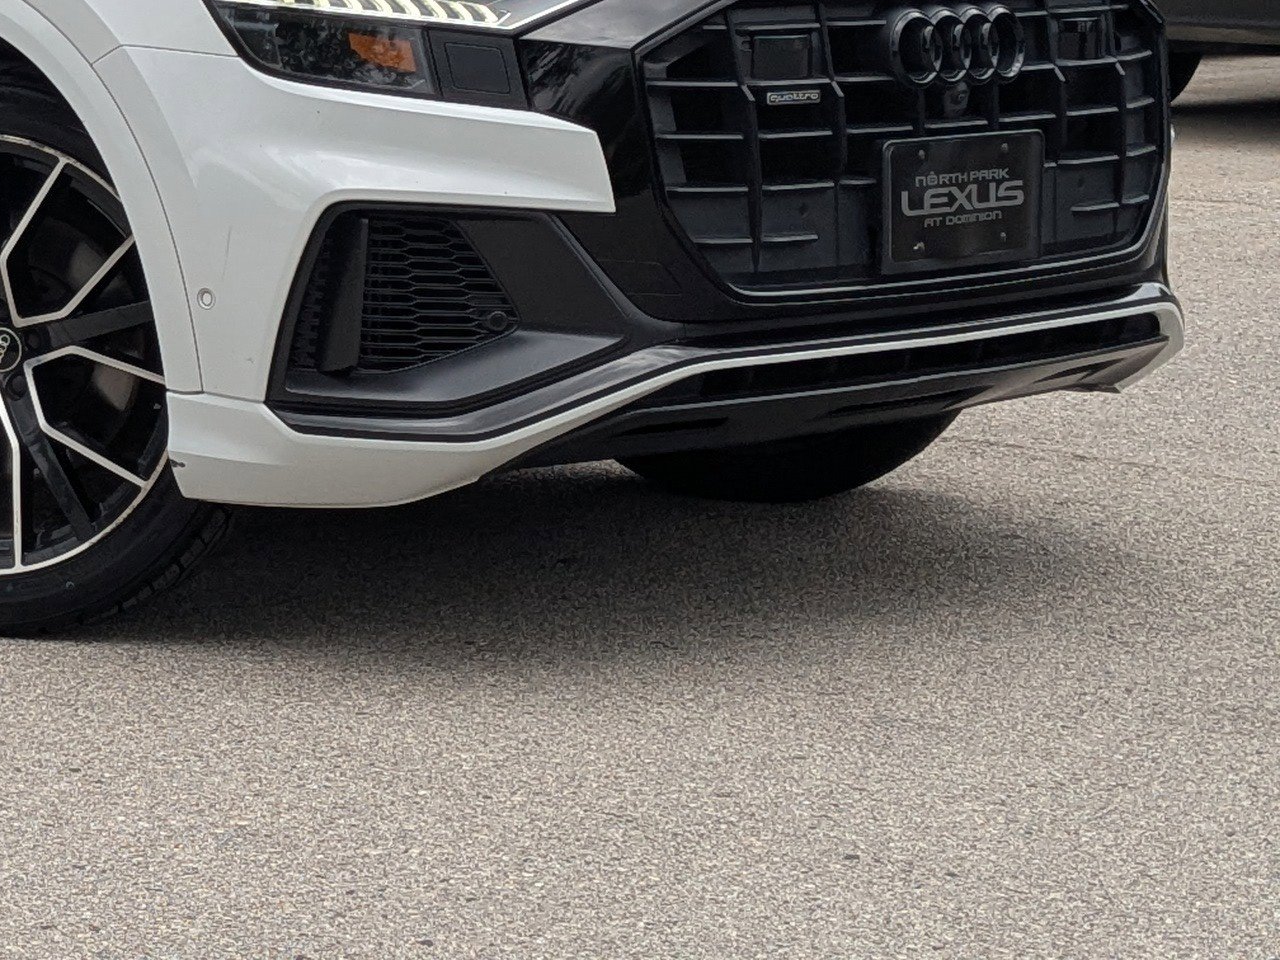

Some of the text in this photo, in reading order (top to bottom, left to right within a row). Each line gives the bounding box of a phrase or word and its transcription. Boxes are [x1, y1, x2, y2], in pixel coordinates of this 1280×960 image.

[770, 93, 819, 102] quattro
[915, 168, 1010, 187] NORTH PARK
[901, 180, 1025, 217] LEXUS
[924, 210, 1002, 228] AT DOMINION
